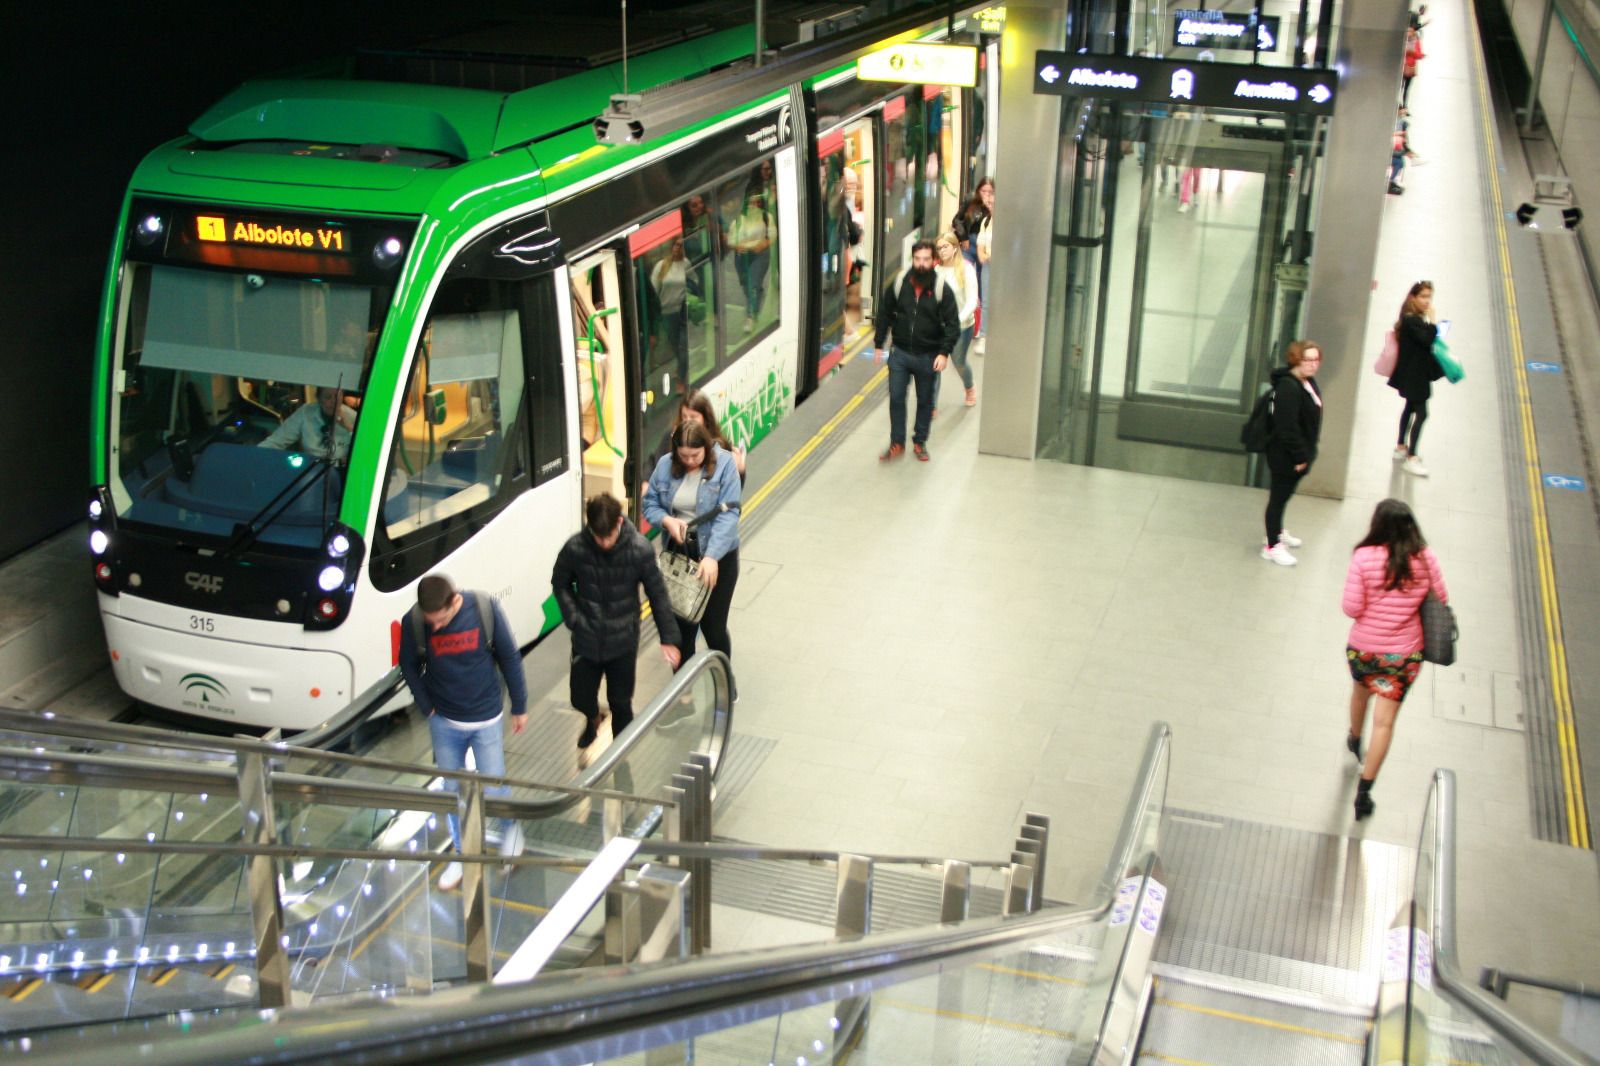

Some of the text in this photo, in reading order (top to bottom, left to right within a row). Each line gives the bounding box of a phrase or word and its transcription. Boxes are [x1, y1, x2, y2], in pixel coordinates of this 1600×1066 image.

[1068, 68, 1138, 89] Albolote
[233, 221, 314, 247] Albolote
[317, 229, 343, 250] V1
[185, 572, 224, 594] CAF
[189, 615, 215, 633] 315
